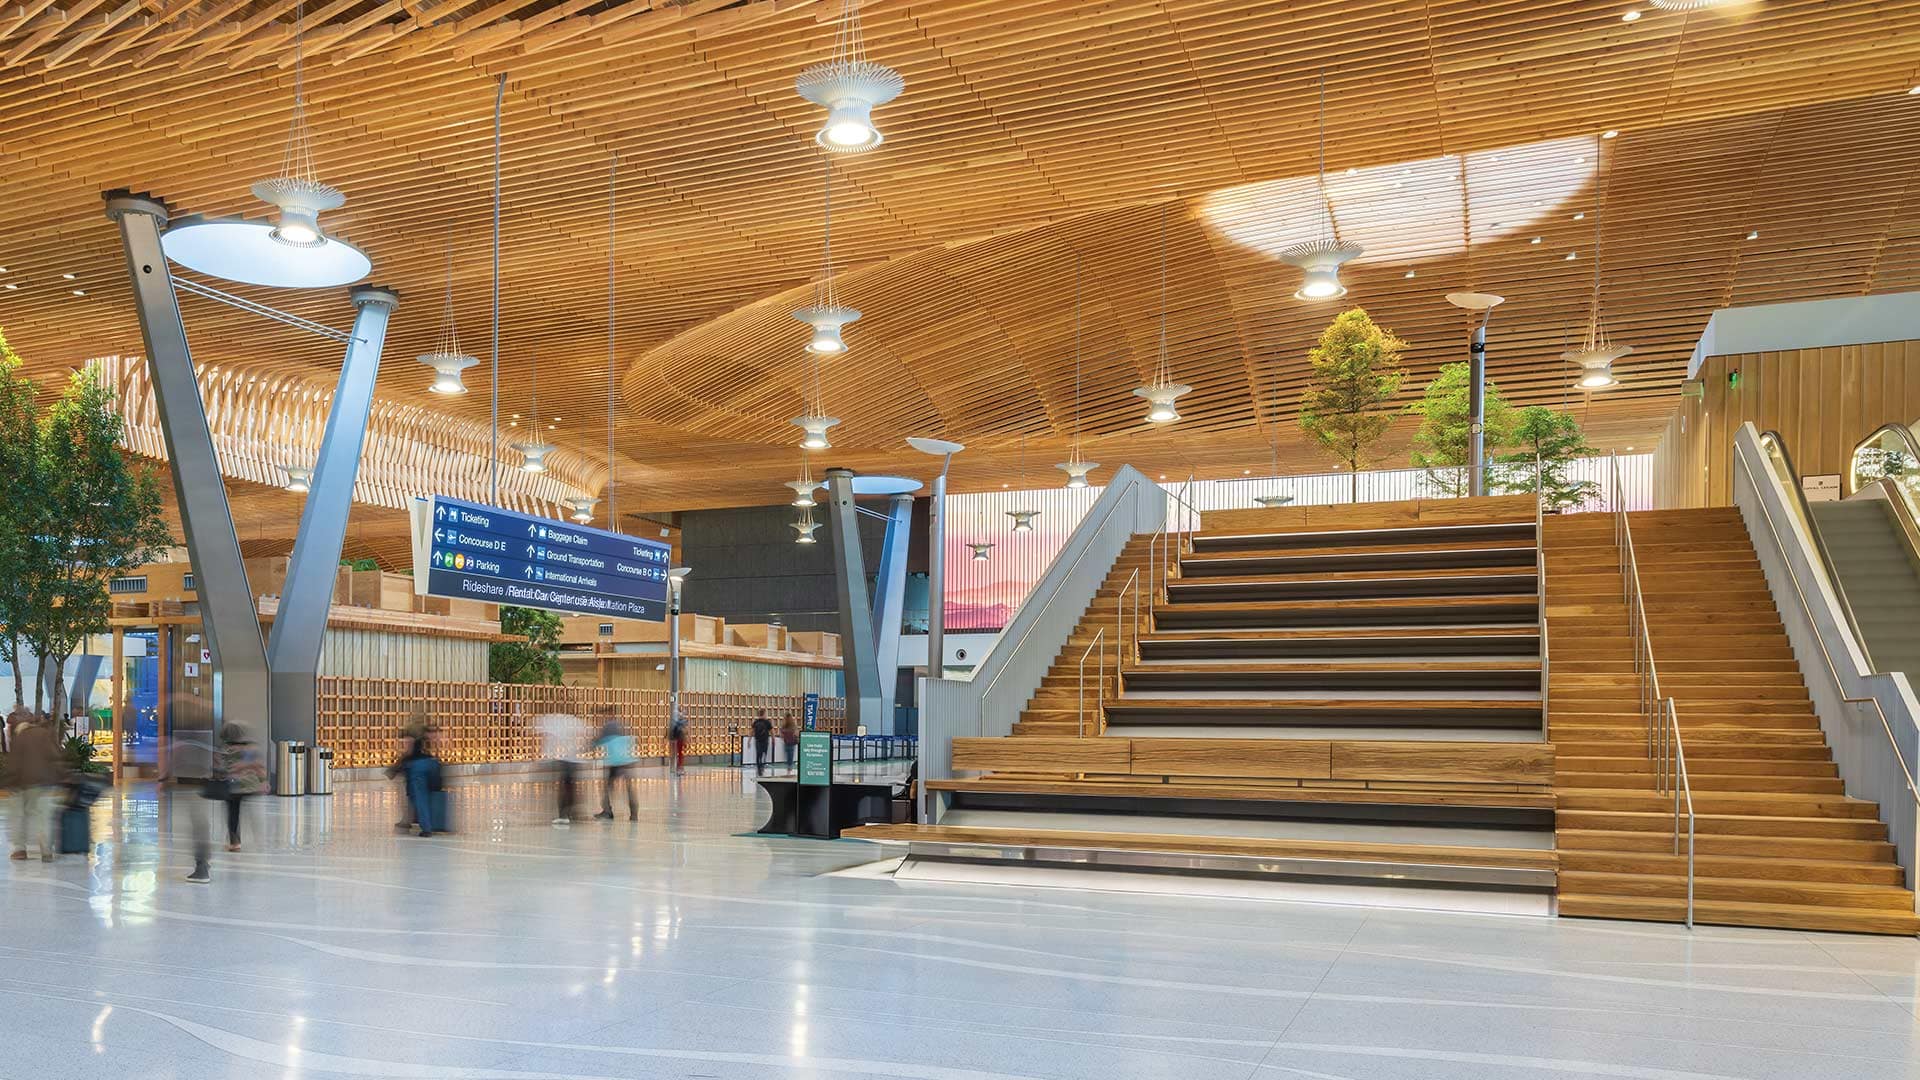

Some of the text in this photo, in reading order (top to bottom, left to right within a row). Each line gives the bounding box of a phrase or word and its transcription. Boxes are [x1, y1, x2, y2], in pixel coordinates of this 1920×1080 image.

[461, 511, 490, 528] Ticketing
[458, 534, 506, 551] Concourse D E
[548, 529, 588, 545] Baggage Claim
[546, 550, 605, 568] Ground Transportation
[633, 546, 653, 560] Ticketing
[466, 559, 474, 567] P3
[476, 559, 500, 574] Parking
[617, 563, 653, 577] Concourse B C
[545, 569, 597, 587] International Arrivals
[462, 579, 504, 596] Rideshare
[628, 602, 645, 614] Plaza
